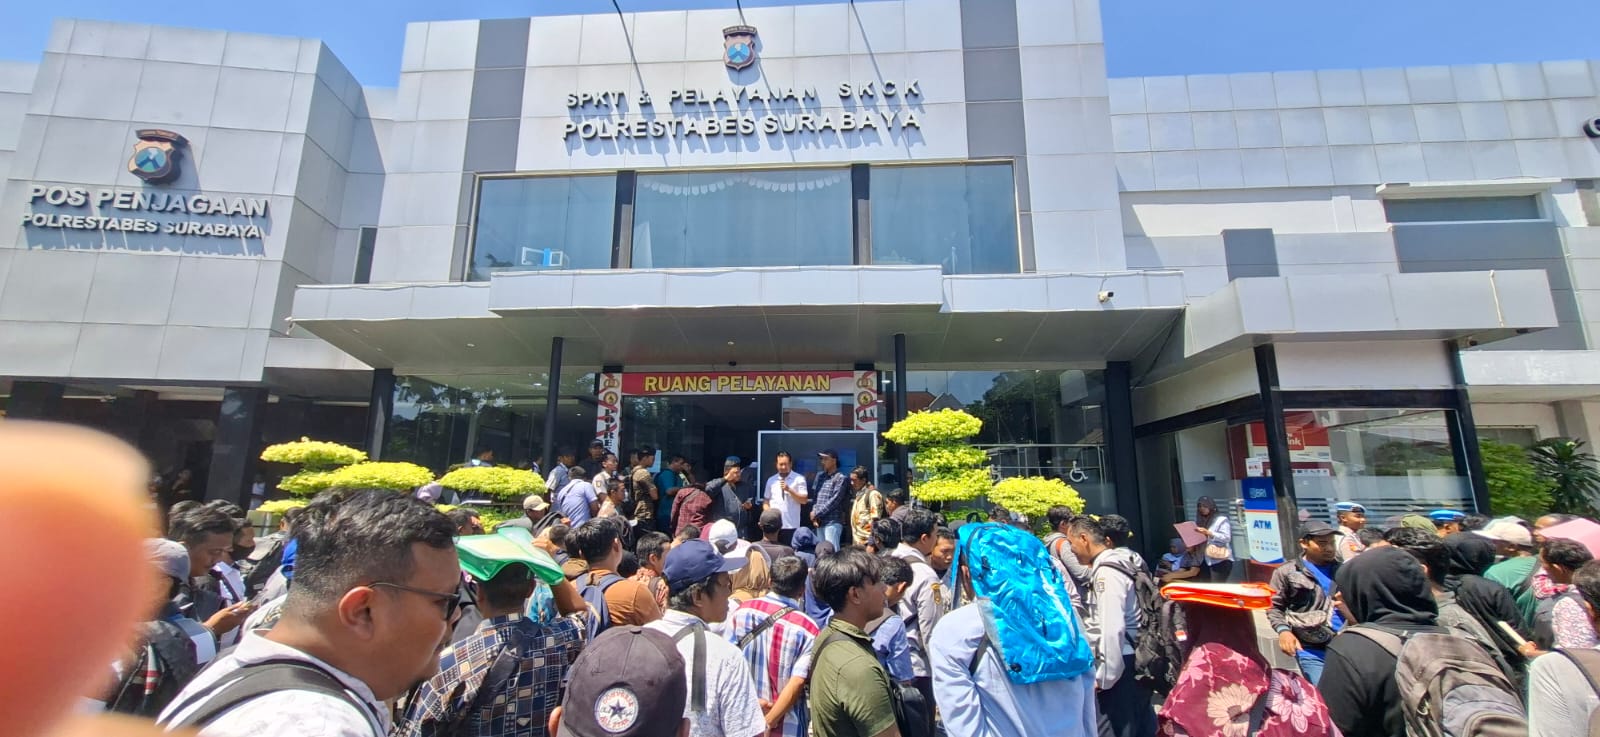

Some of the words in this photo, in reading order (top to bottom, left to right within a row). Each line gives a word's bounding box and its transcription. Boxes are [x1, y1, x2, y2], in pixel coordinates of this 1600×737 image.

[566, 90, 626, 108] SPKT
[638, 91, 652, 105] &
[669, 85, 818, 104] PELAYANAN
[562, 116, 755, 140] POLRESTABES
[763, 111, 921, 134] SURABAYA
[30, 184, 90, 207] POS
[97, 189, 268, 217] PENJAGAAN
[21, 213, 158, 233] POLRESTABES
[163, 220, 267, 240] SURABAYA
[644, 375, 712, 393] RUANG
[717, 374, 831, 392] PELAYANAN
[1253, 520, 1272, 530] ATM
